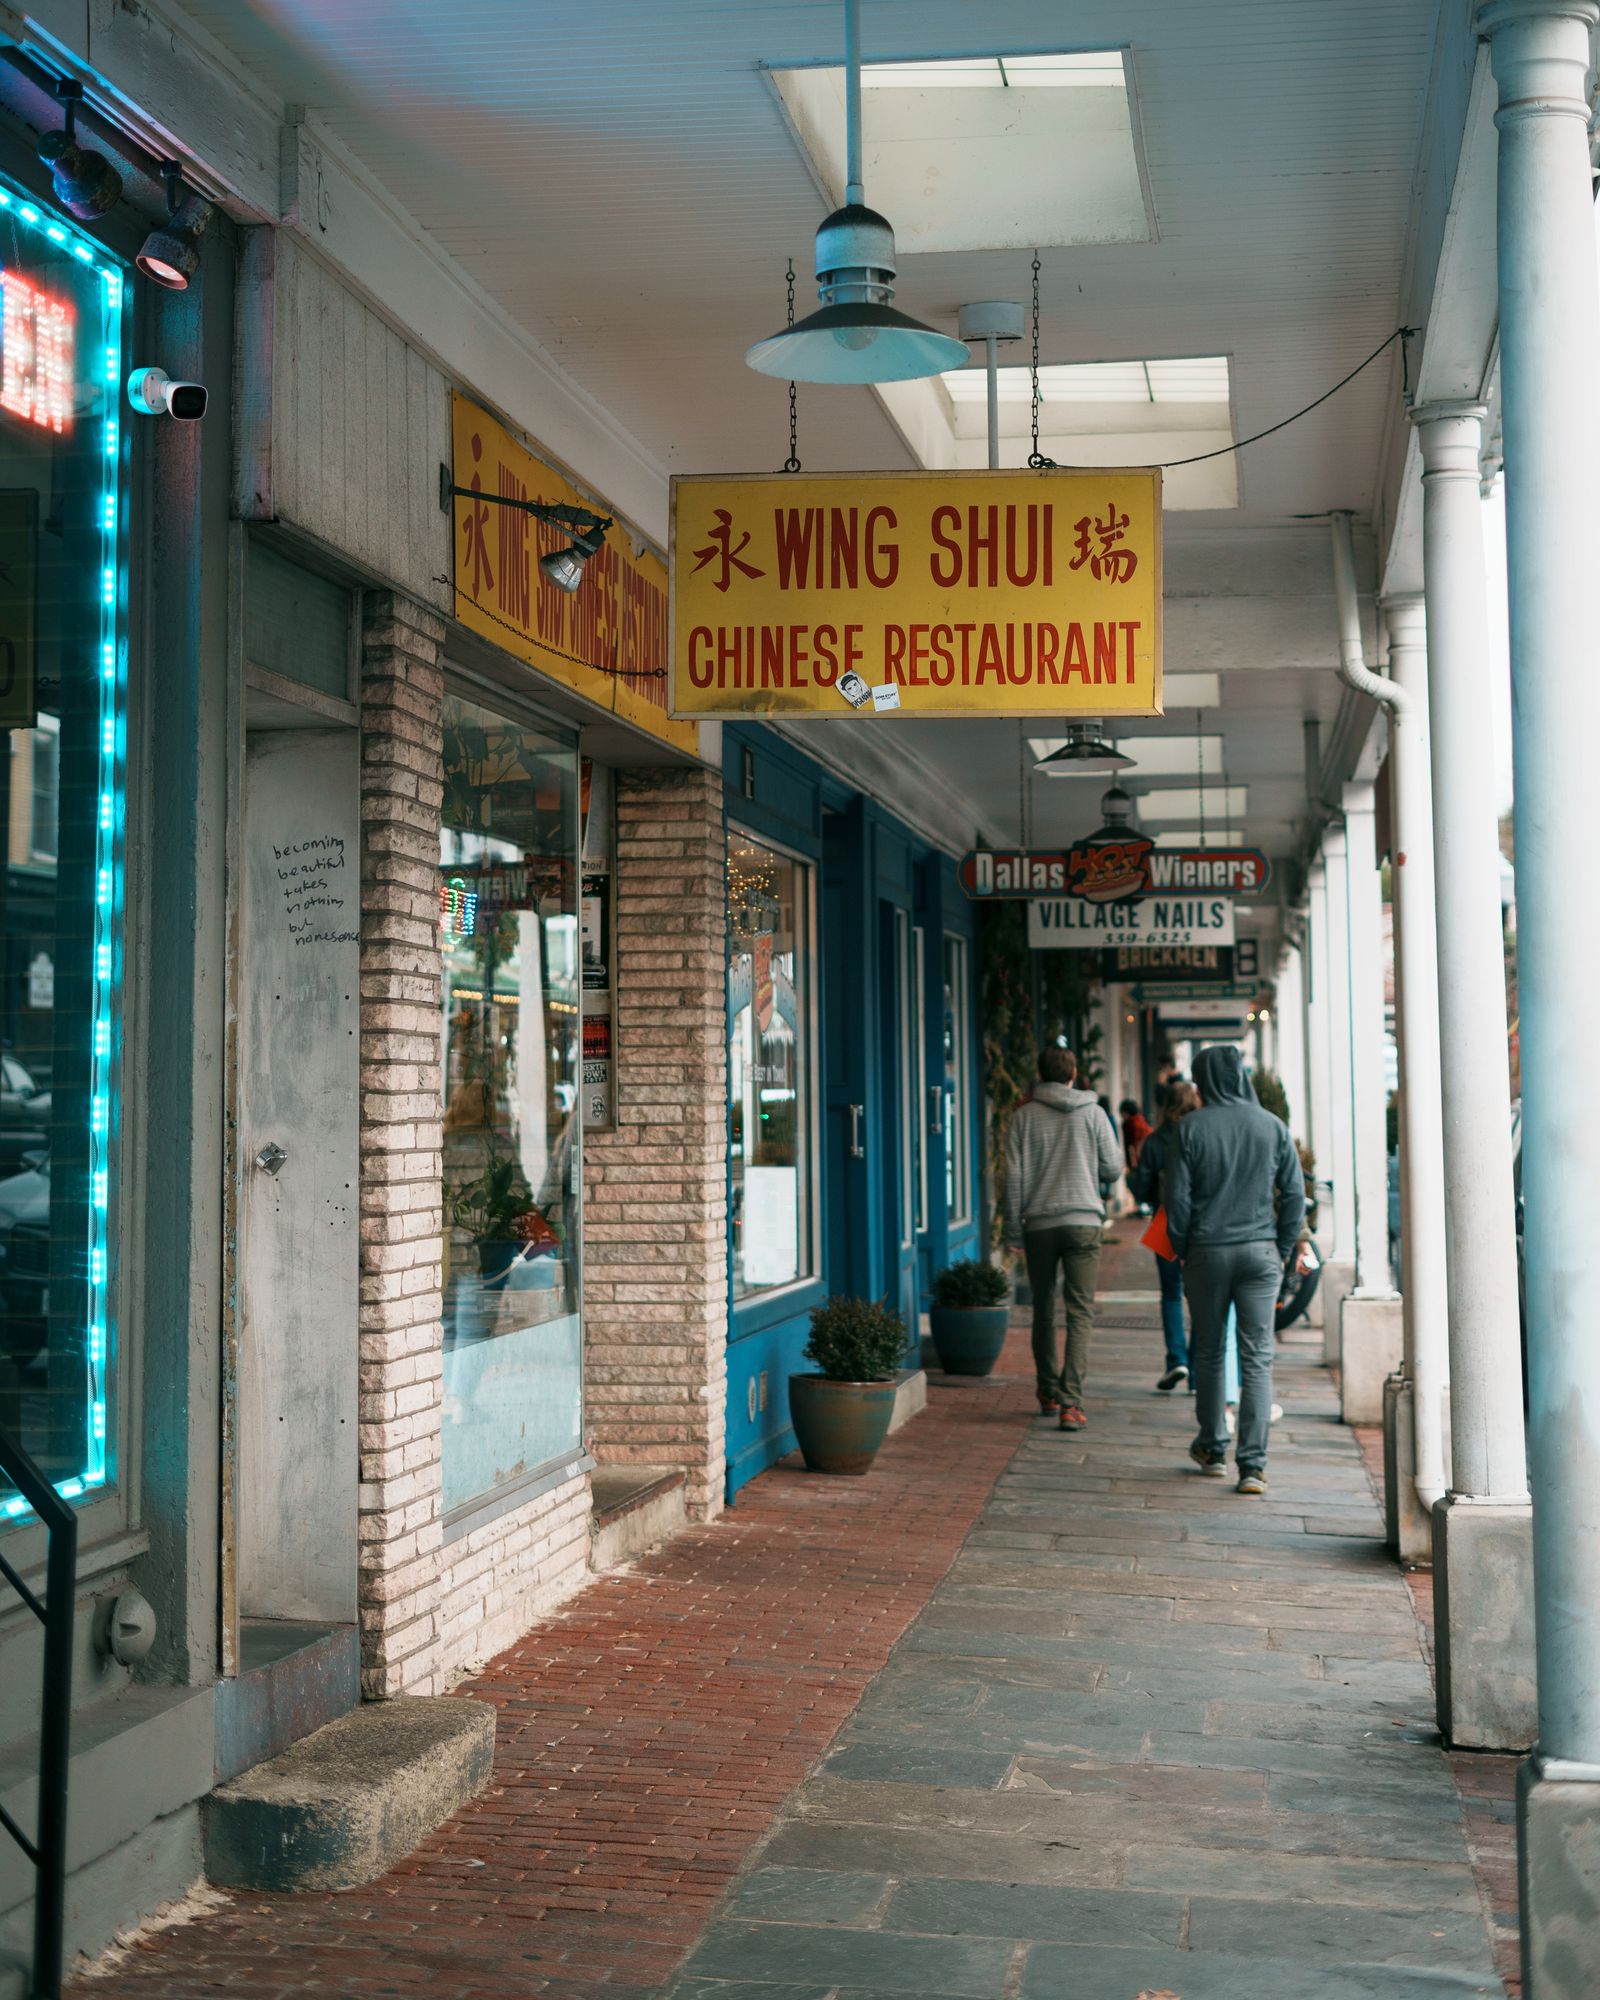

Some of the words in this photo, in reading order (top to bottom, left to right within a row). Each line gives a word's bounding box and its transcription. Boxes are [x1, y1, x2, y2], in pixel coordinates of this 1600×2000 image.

[498, 460, 530, 631] WING
[690, 508, 767, 593] 永
[774, 505, 899, 591] WING
[930, 504, 1054, 588] SHUI
[1068, 502, 1138, 586] 瑞
[688, 624, 863, 689] CHINESE
[884, 621, 1142, 687] RESTAURANT
[272, 834, 345, 860] becoming
[277, 855, 345, 880] beautiful
[975, 853, 1064, 895] Dallas
[1070, 841, 1152, 877] HOT
[1150, 855, 1256, 887] Wieners
[283, 878, 328, 898] takes
[288, 917, 314, 933] but
[1039, 901, 1141, 928] VILLAGE
[1153, 901, 1224, 928] NAILS
